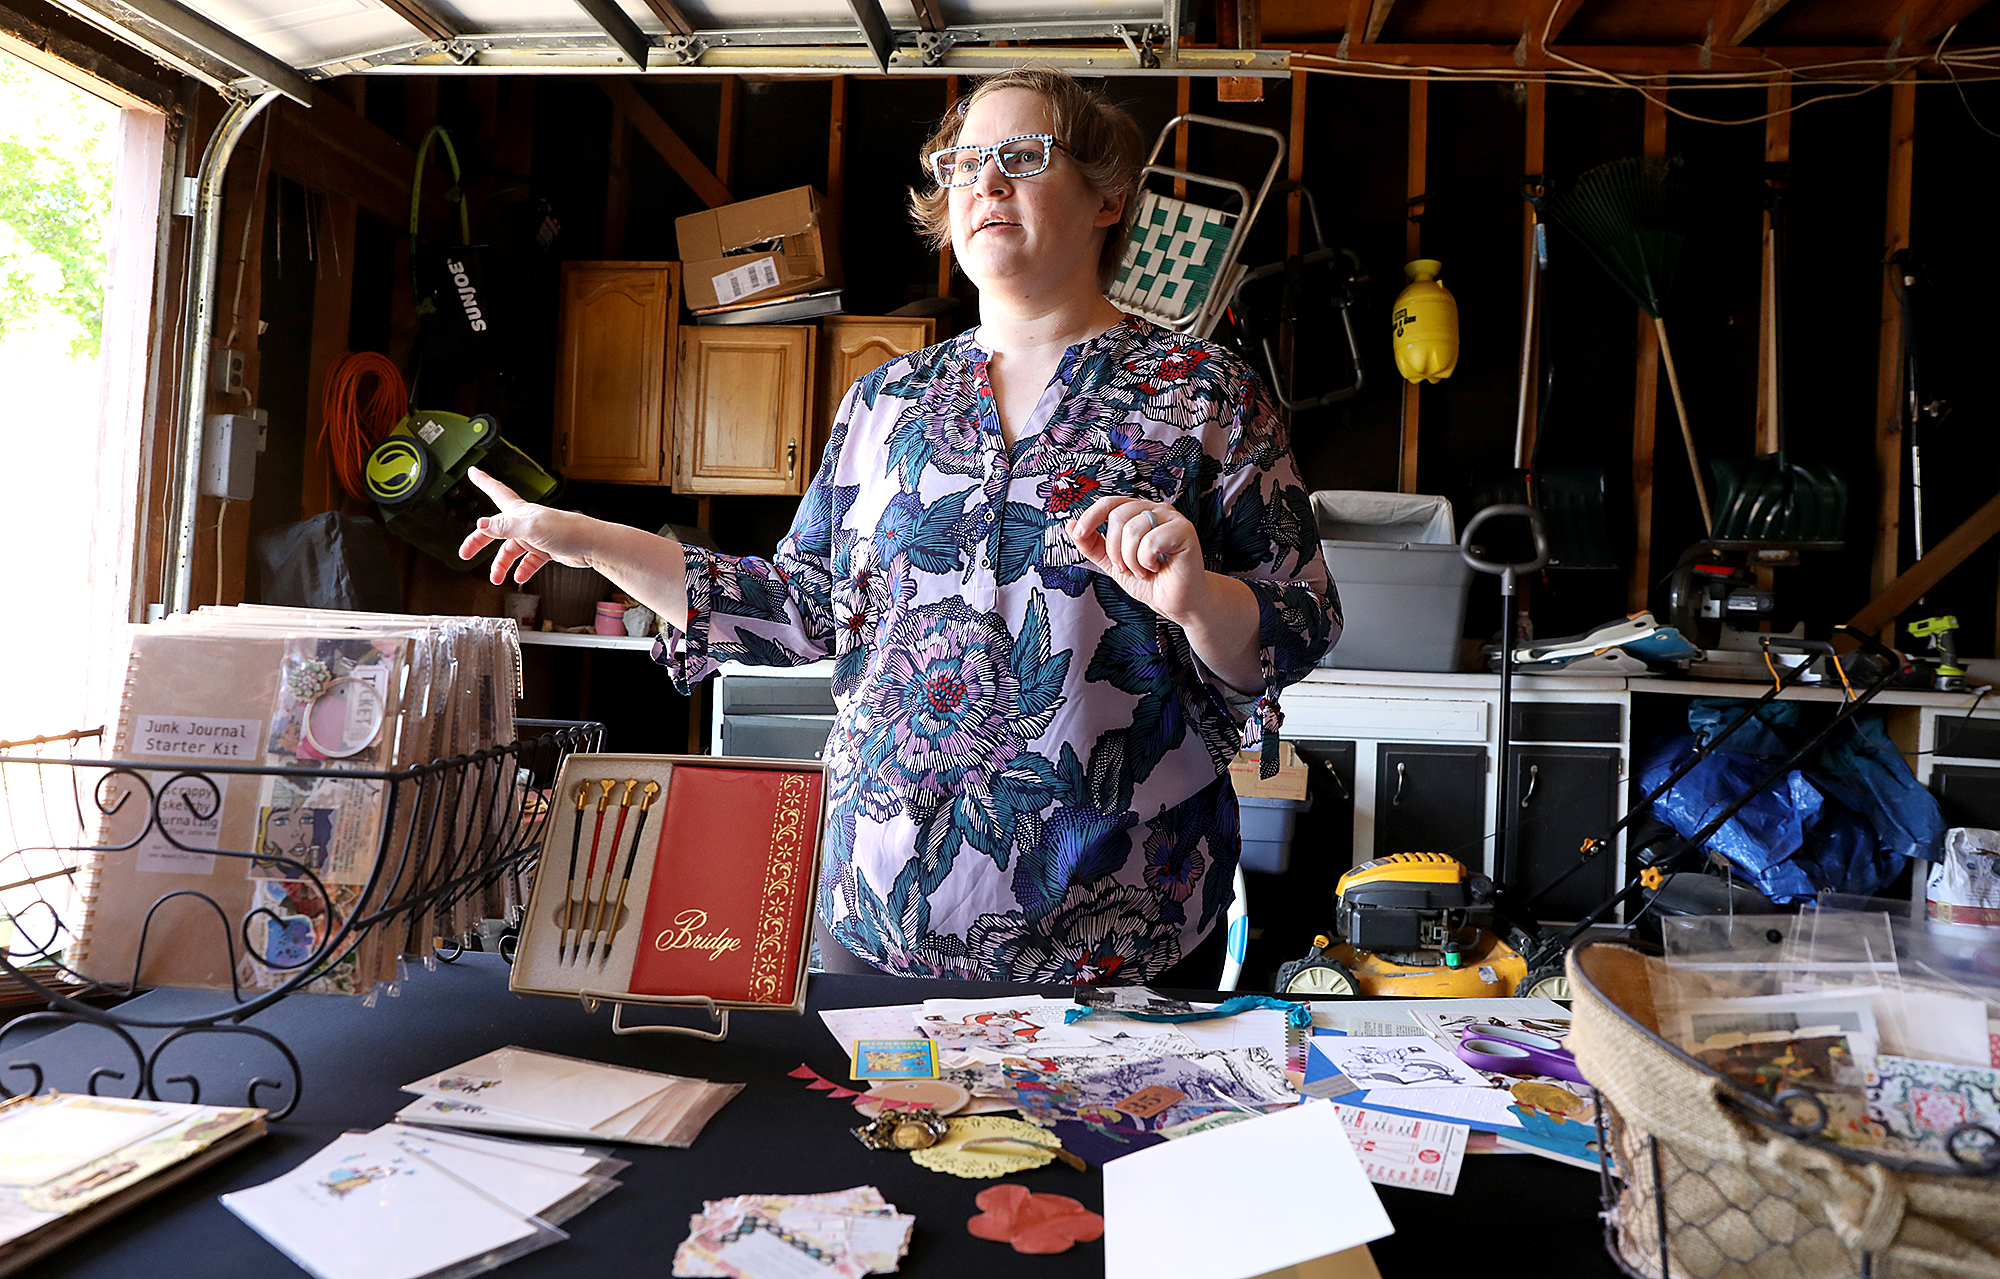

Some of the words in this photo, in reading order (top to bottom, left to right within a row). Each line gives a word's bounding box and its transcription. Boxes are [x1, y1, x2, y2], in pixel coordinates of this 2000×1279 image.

[356, 675, 376, 725] TCKET
[145, 720, 180, 734] Junk
[187, 723, 246, 739] Journal
[146, 738, 206, 754] Starter
[212, 742, 239, 756] Kit
[655, 909, 742, 962] Bridge
